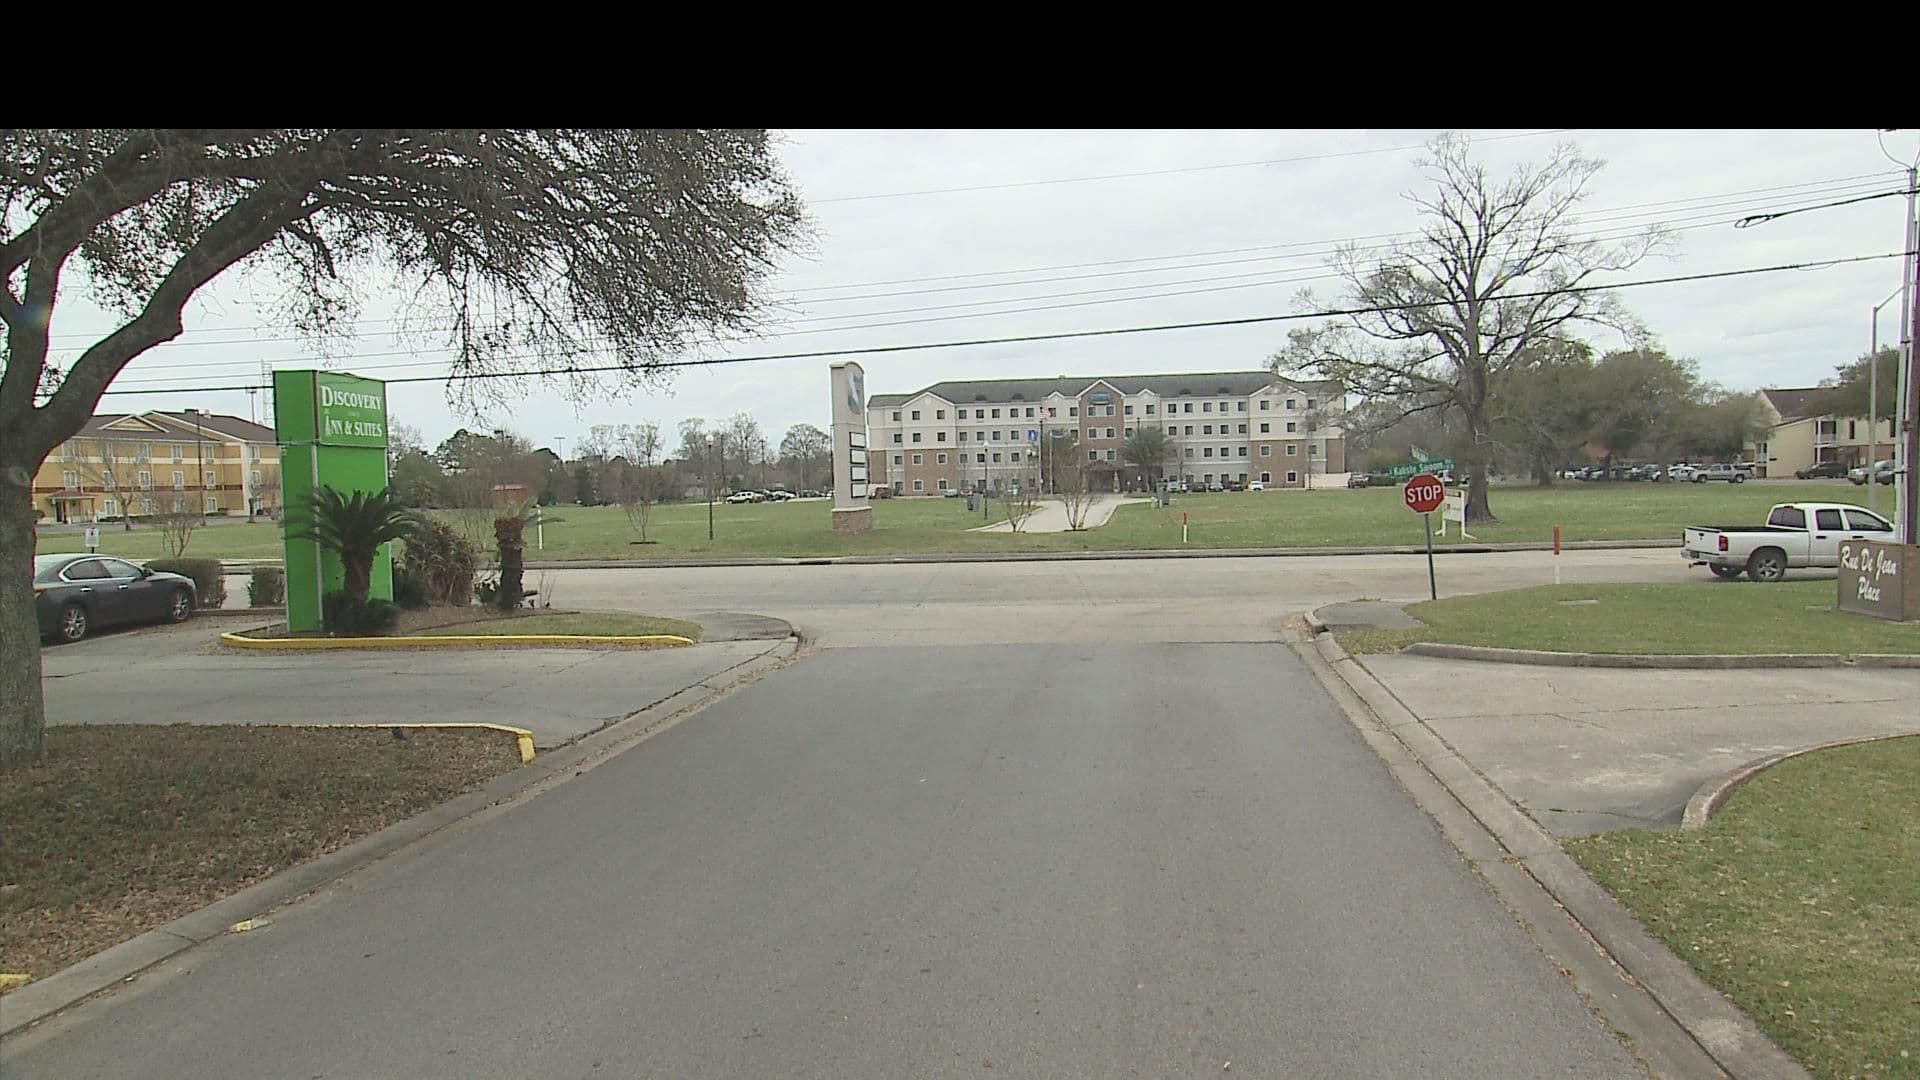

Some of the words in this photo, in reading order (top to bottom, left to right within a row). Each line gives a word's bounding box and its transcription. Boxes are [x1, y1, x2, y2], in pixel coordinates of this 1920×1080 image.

[320, 385, 381, 410] DISCOVERY
[345, 420, 353, 435] &
[354, 421, 382, 437] SUITES
[1407, 484, 1441, 503] STOP
[1841, 545, 1858, 570] Rue
[1861, 548, 1873, 572] De
[1875, 549, 1897, 581] Jean
[1857, 576, 1881, 602] Place
